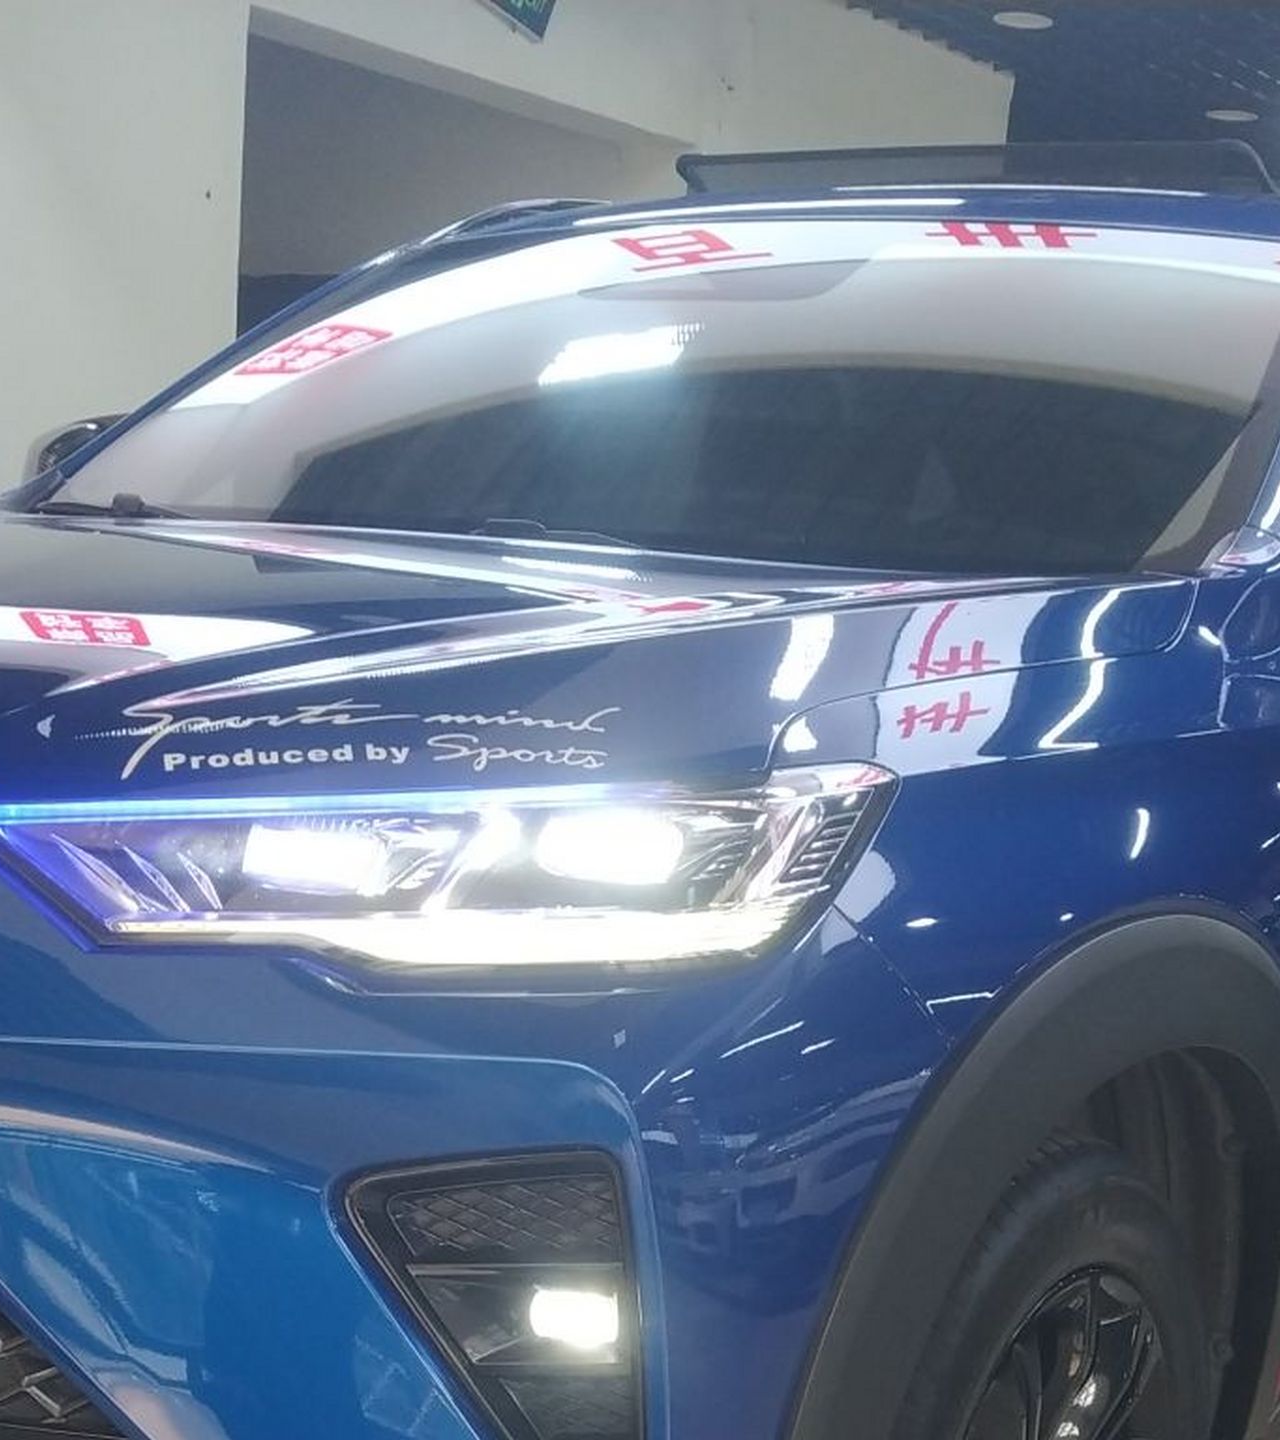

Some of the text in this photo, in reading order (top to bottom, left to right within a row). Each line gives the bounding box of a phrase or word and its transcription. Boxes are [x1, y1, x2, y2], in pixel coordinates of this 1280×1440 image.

[163, 733, 609, 772] Produced by Sports
